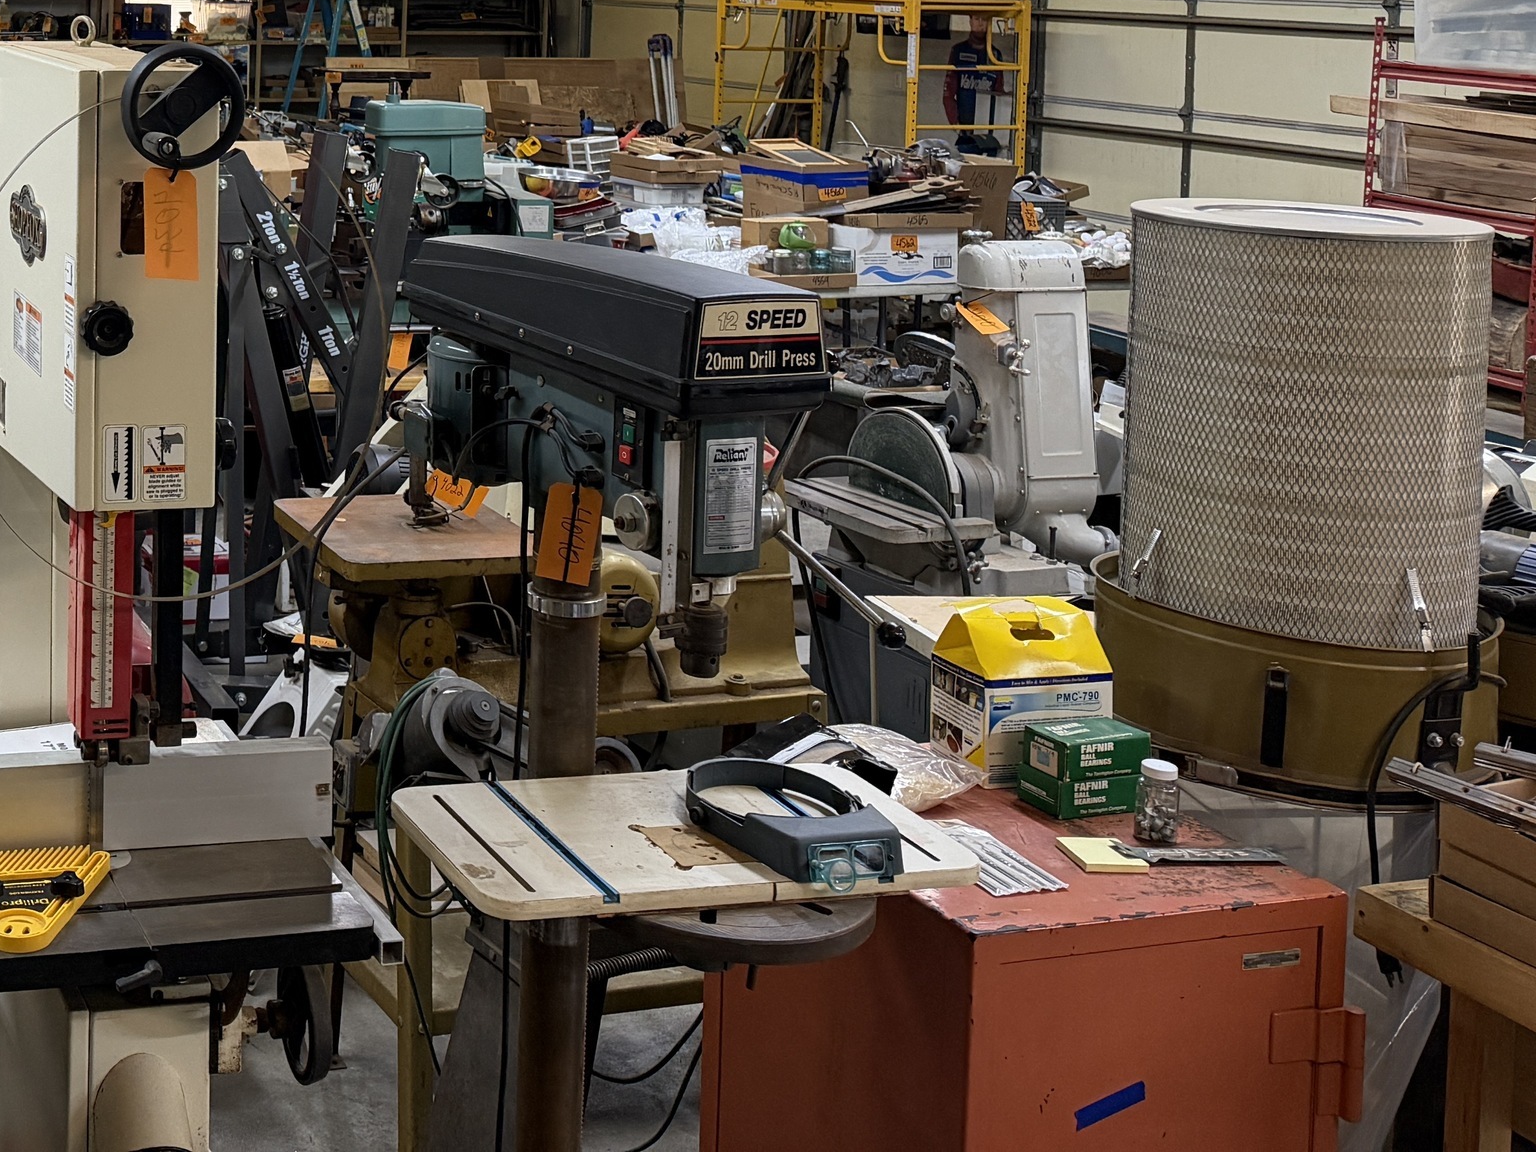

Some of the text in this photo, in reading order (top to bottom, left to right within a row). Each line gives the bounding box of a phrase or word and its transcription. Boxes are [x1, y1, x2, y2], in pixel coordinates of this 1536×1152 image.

[718, 308, 807, 331] 12 SPEED
[705, 349, 816, 371] 20mm Drill Press
[440, 476, 464, 497] 4022
[1080, 742, 1114, 754] FAFNIR
[1080, 758, 1112, 768] BEARINGS
[1074, 780, 1109, 792] FAFNIR
[1074, 791, 1090, 799] BALL
[1074, 796, 1107, 806] BEARINGS
[1, 898, 50, 906] Drillpro
